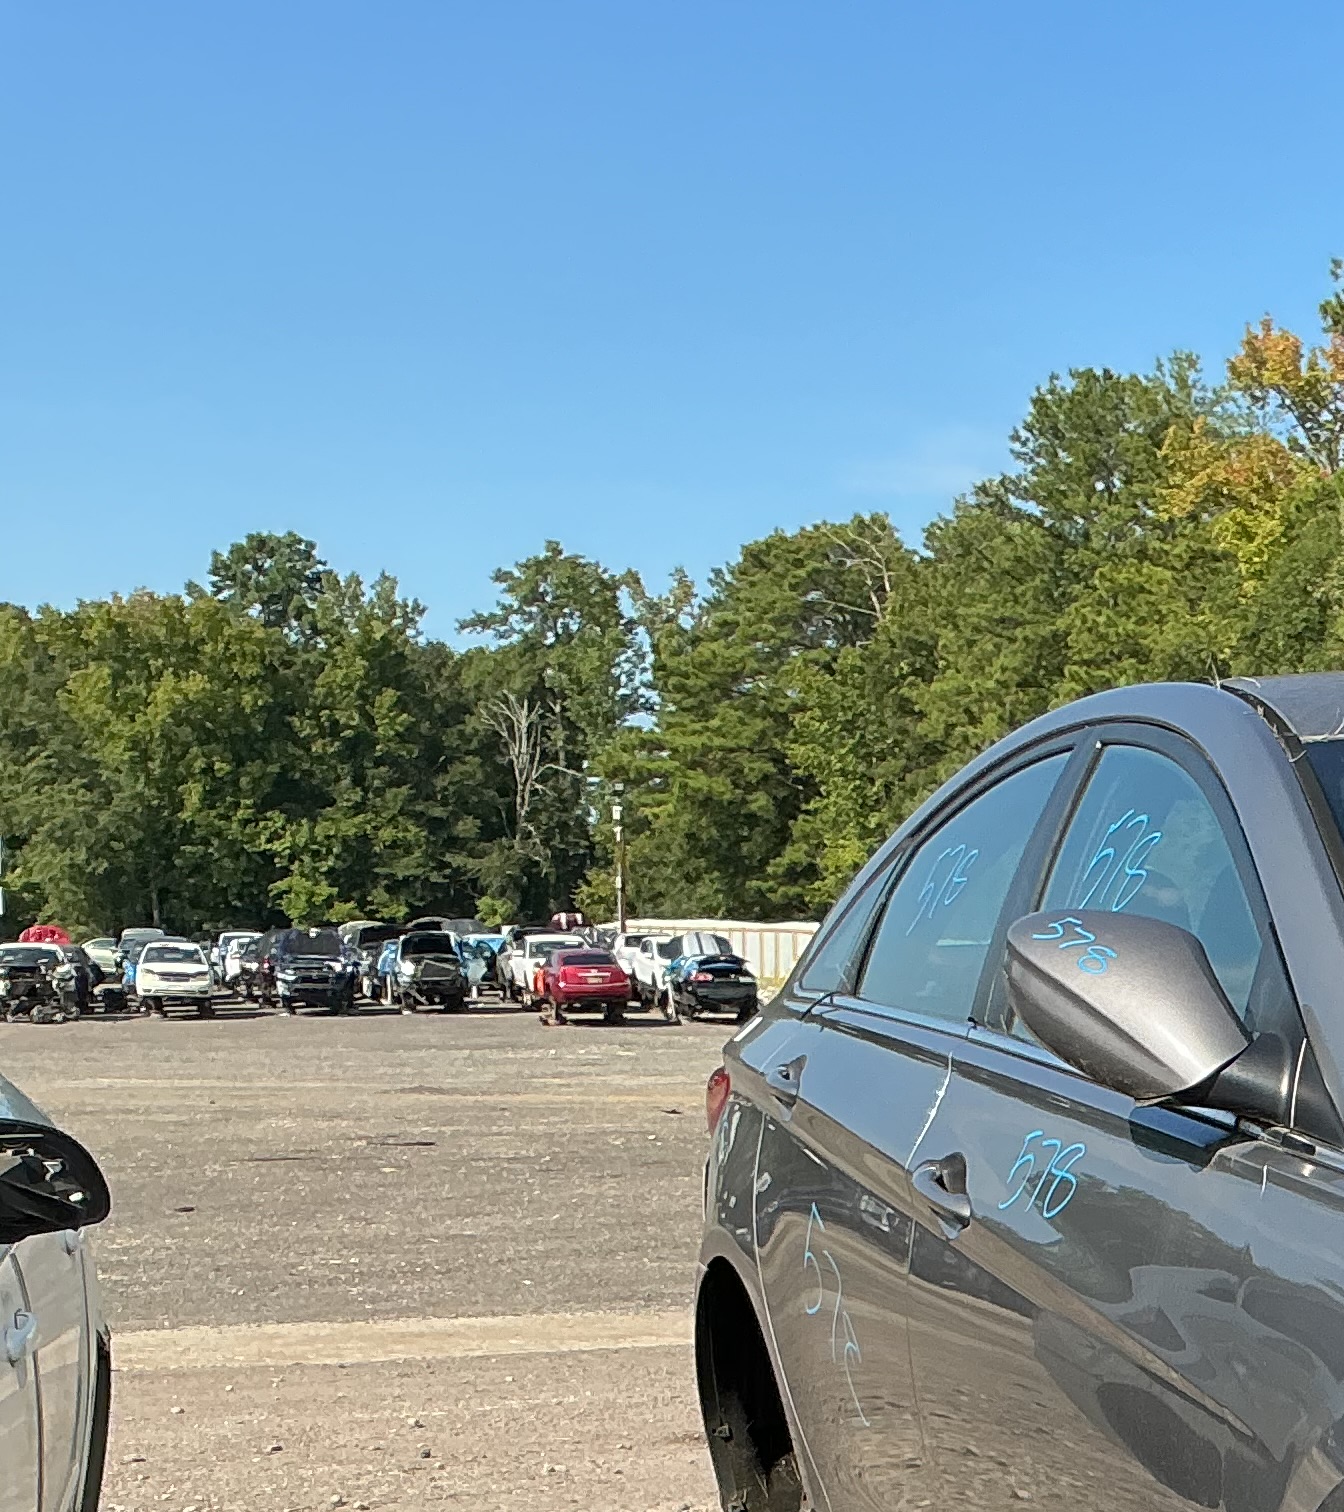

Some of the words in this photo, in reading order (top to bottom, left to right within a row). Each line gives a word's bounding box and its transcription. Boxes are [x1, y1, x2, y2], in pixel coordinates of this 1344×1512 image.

[906, 843, 979, 936] 578
[1079, 809, 1162, 912] 578
[1031, 916, 1118, 975] 578
[998, 1130, 1088, 1219] 578
